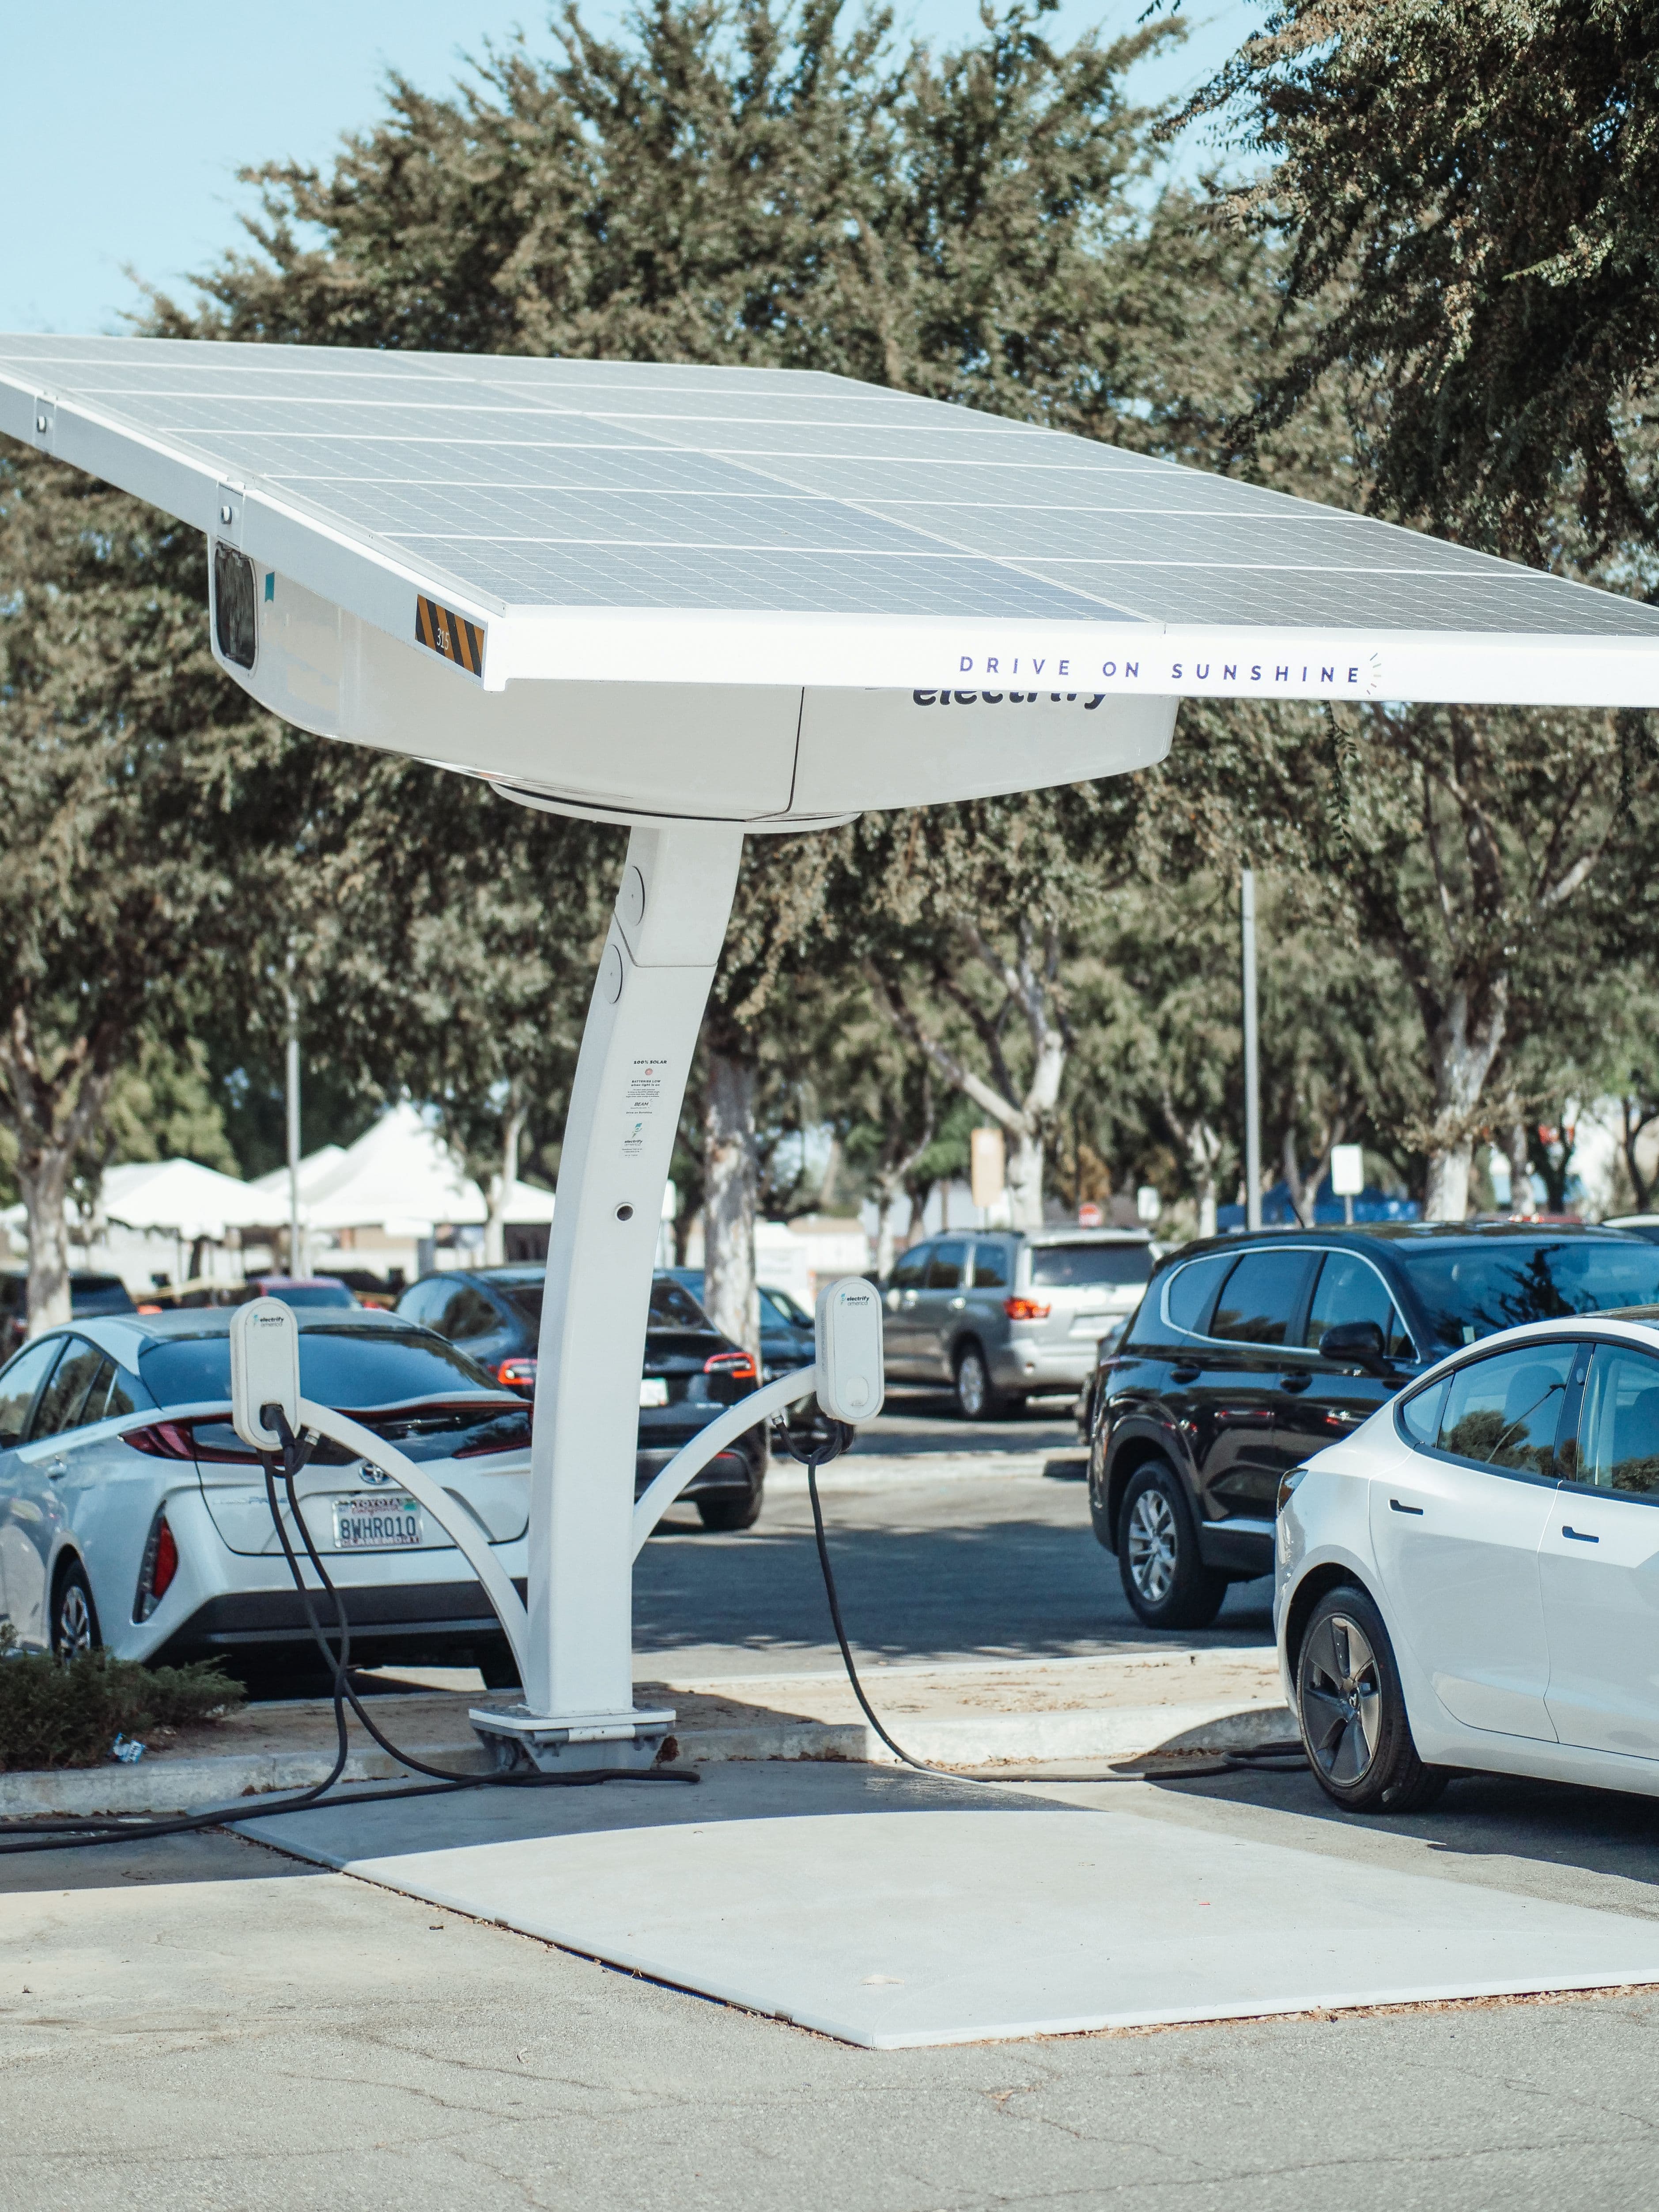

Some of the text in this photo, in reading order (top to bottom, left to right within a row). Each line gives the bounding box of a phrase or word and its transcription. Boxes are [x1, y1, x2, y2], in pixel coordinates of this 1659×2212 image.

[437, 628, 449, 650] 315
[960, 656, 1358, 683] DRIVE ON SUNSHINE
[340, 1516, 416, 1539] 8WHR010
